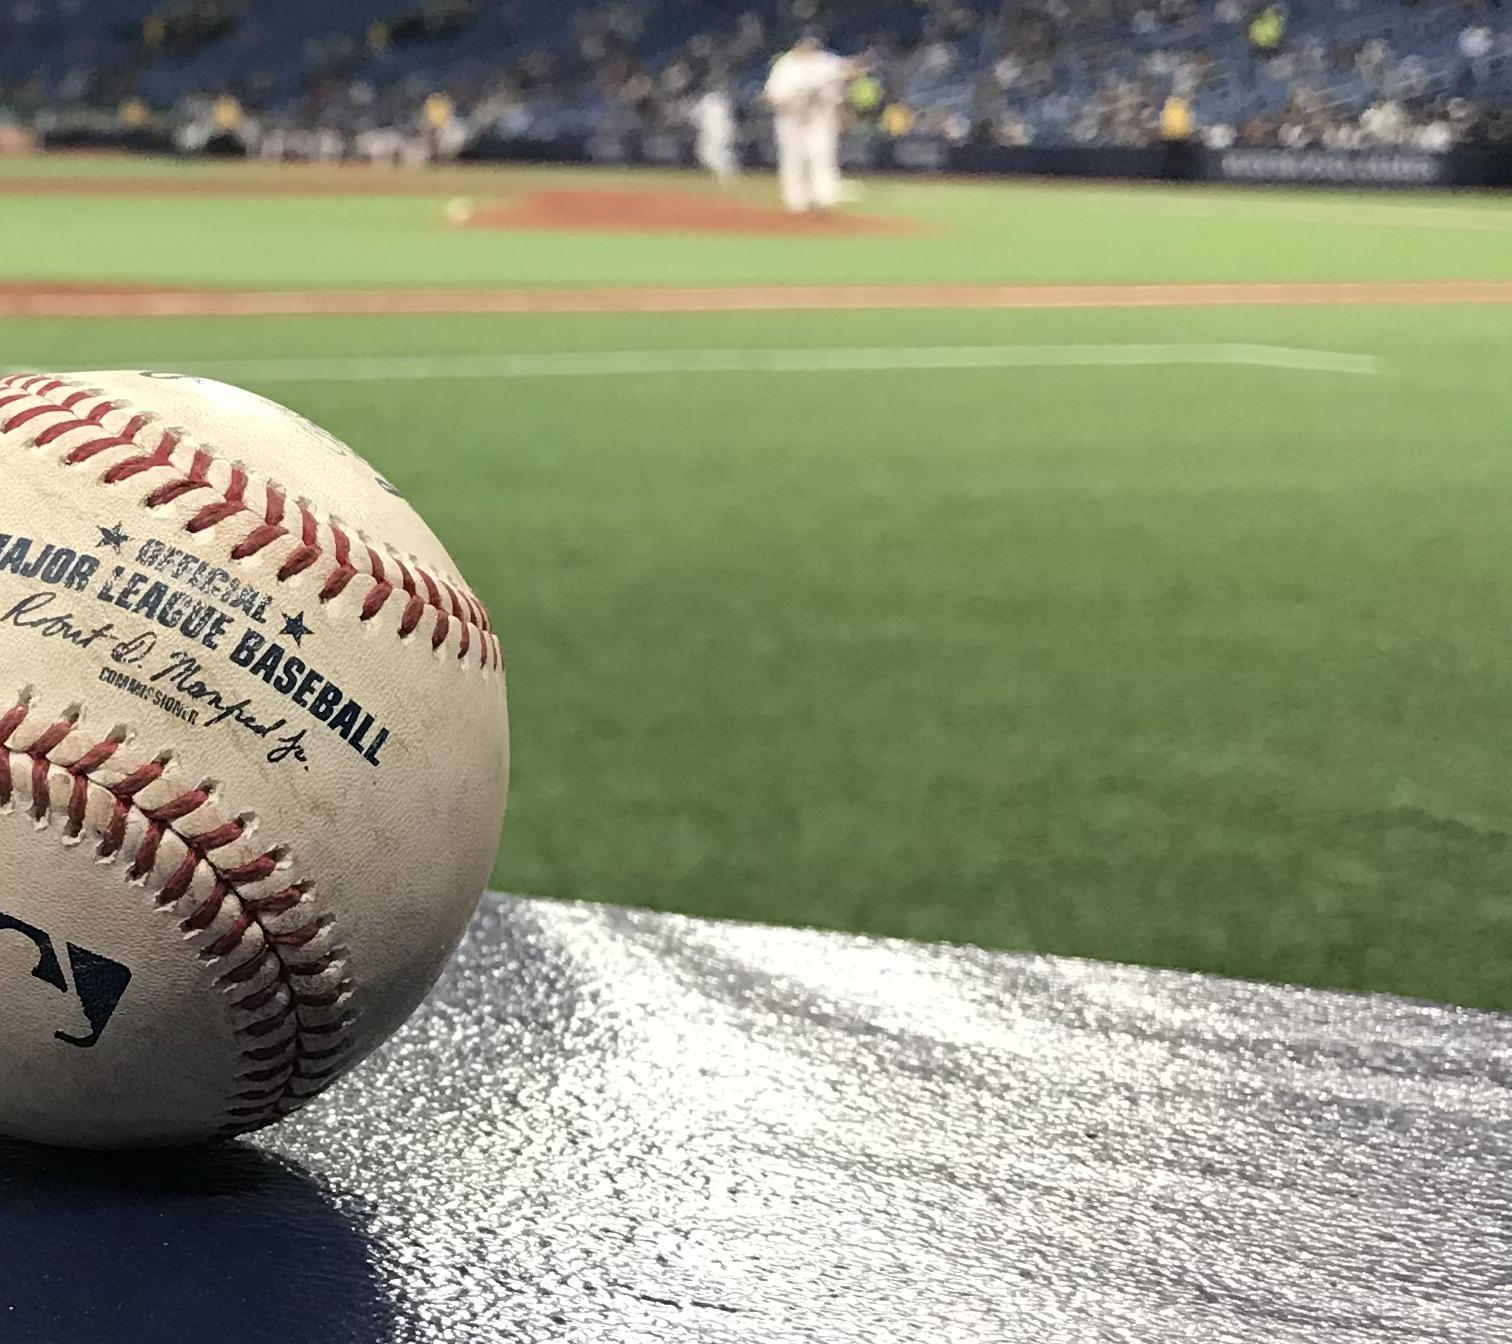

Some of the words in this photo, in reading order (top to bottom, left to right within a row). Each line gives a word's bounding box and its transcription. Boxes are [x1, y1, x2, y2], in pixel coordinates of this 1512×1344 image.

[135, 538, 273, 624] OFFICIAL
[96, 565, 234, 651] LEAGUE
[229, 627, 390, 767] BASEBALL
[97, 665, 200, 727] COMMISSIONER
